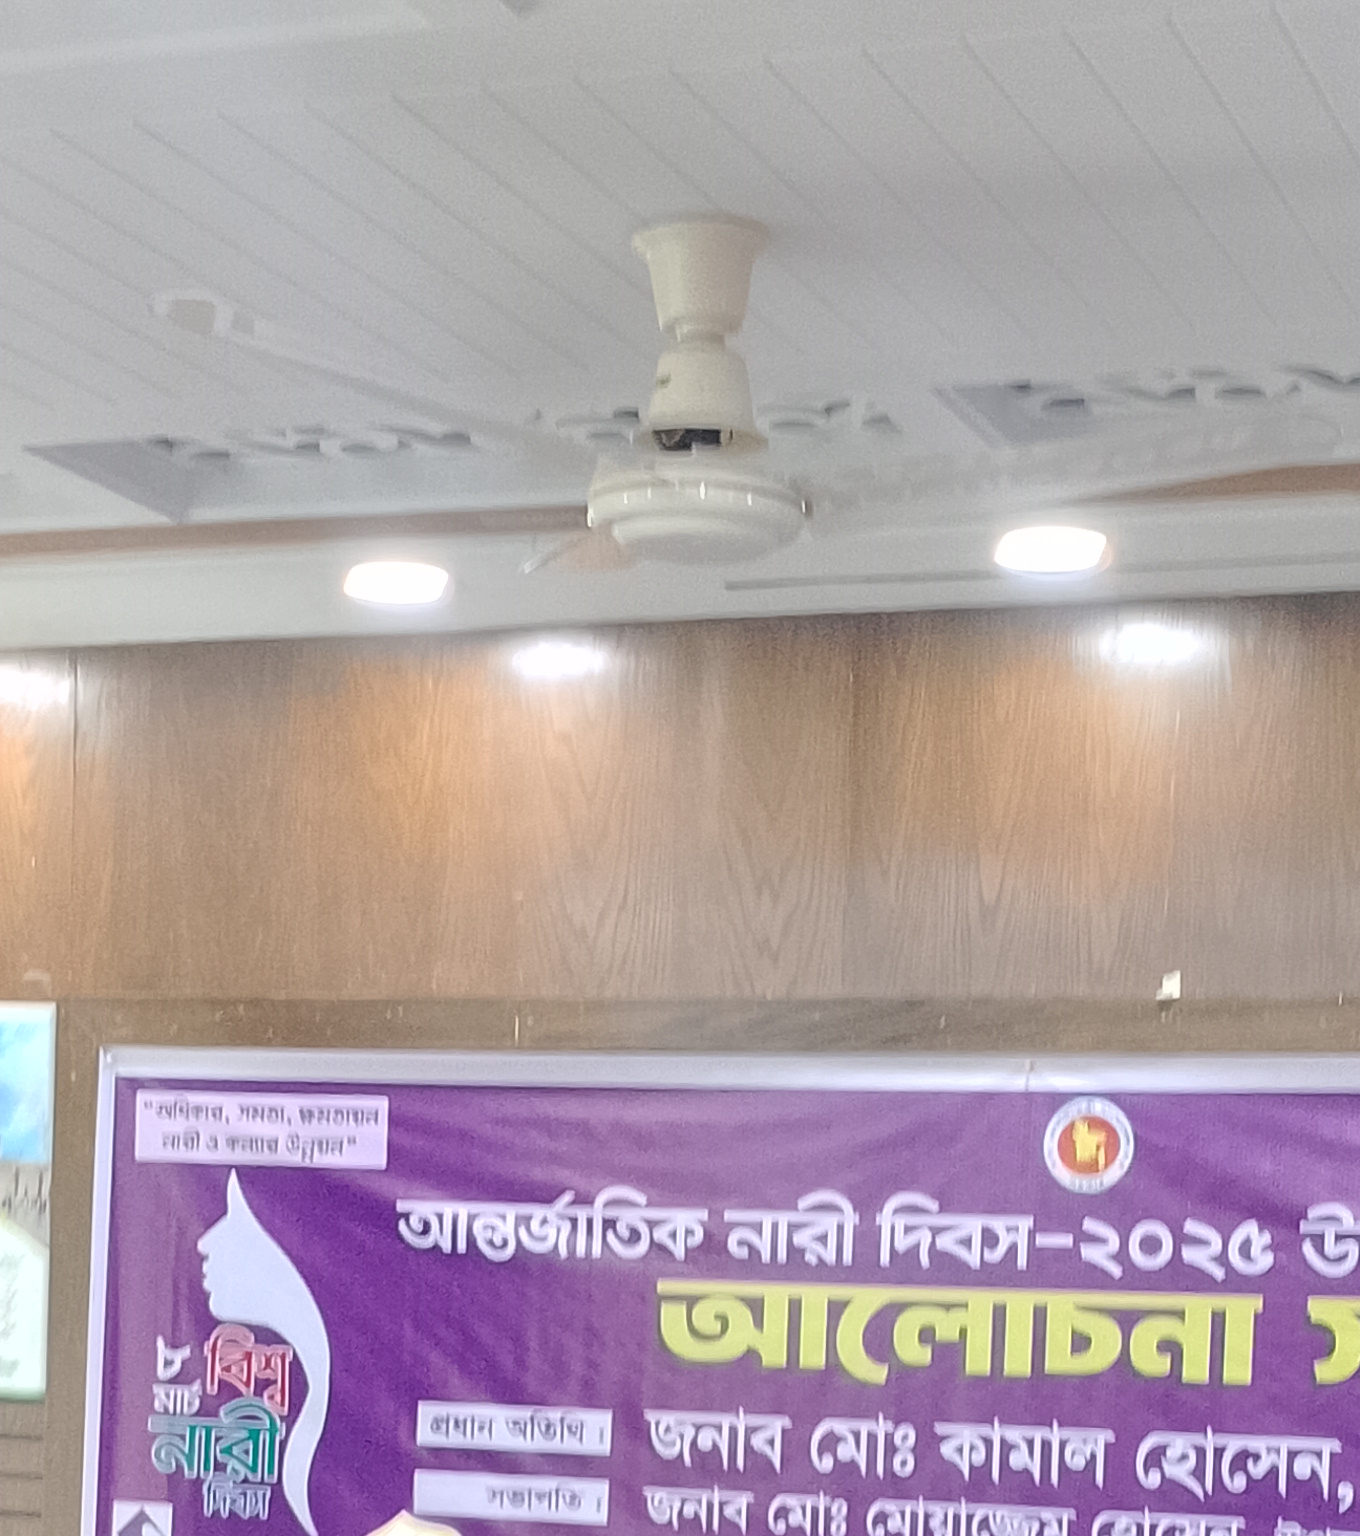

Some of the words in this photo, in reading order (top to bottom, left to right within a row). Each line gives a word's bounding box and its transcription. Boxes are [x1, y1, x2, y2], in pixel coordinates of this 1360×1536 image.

[395, 1184, 709, 1263] আন্তর্জাতিক
[723, 1189, 860, 1268] নারী
[656, 1277, 1264, 1386] আলোচনা
[147, 1396, 286, 1485] নারী
[642, 1405, 792, 1475] জনাব
[809, 1411, 918, 1481] মোঃ
[934, 1416, 1116, 1490] কামাল
[1135, 1425, 1355, 1514] হোসেন,
[642, 1484, 755, 1536] জনাব
